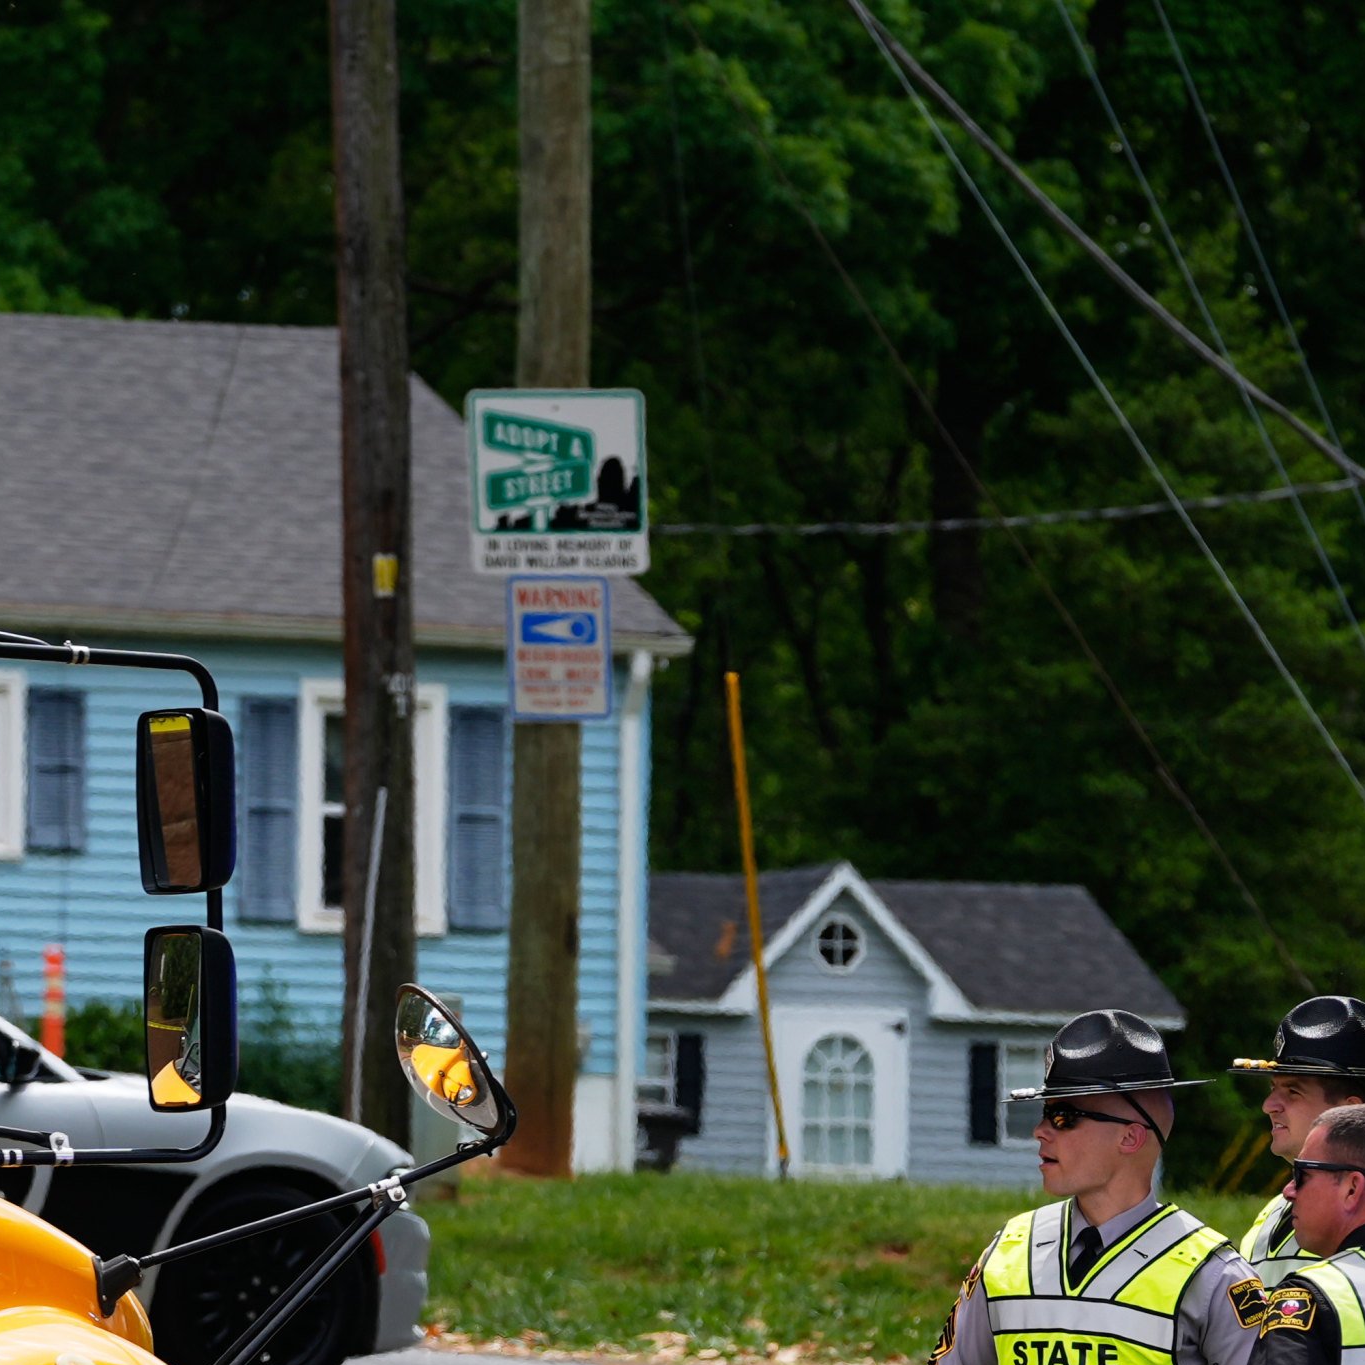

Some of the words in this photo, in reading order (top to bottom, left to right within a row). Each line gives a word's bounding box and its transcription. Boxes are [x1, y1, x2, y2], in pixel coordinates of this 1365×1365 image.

[494, 421, 559, 452] ADOPT
[569, 436, 583, 458] A
[503, 469, 574, 500] STREET
[517, 586, 601, 609] WARNING
